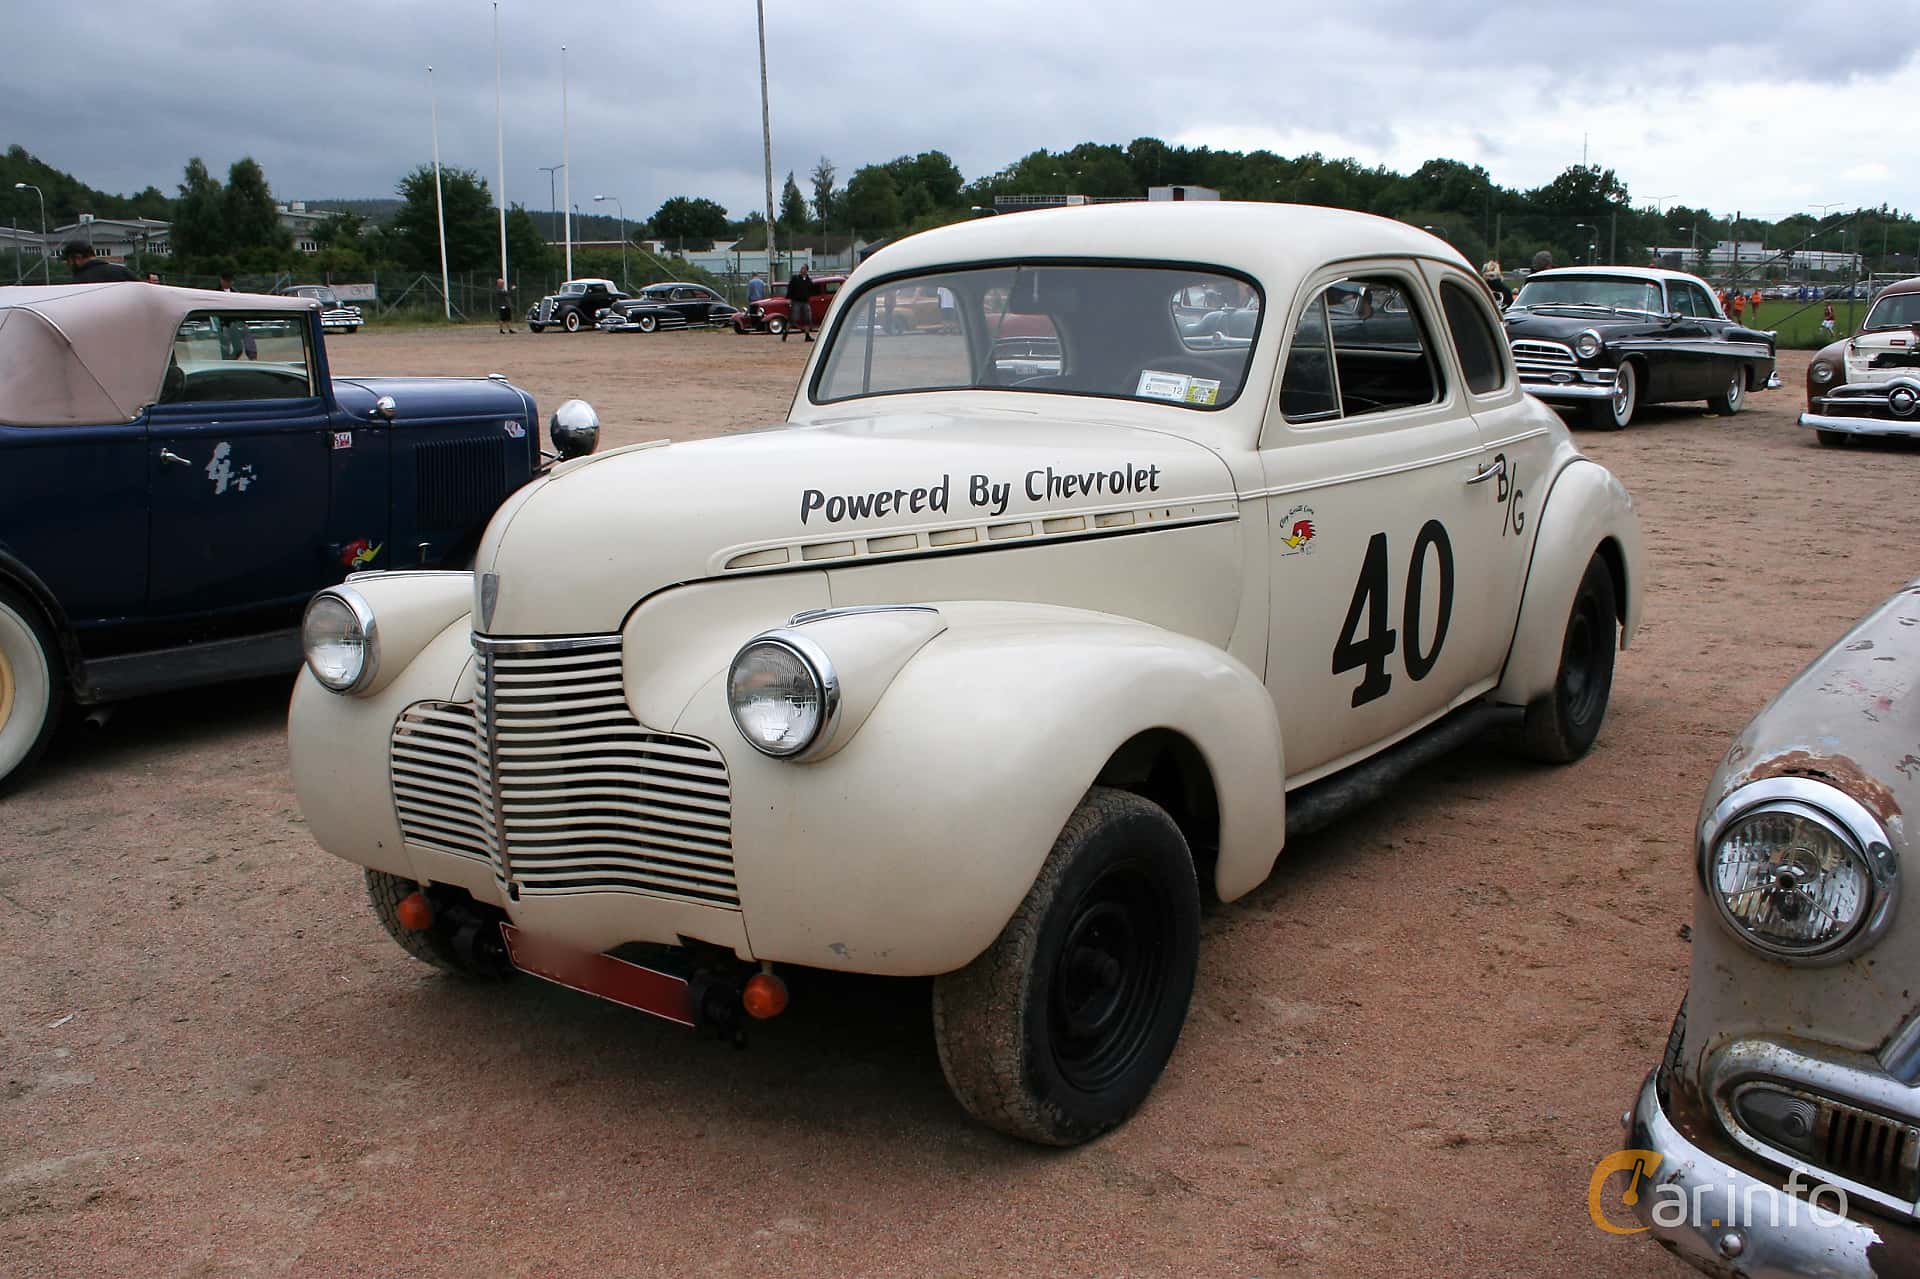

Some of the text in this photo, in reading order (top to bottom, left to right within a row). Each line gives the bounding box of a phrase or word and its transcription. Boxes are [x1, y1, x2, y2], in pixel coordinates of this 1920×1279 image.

[800, 463, 1161, 525] Powered By Chevrolet
[1332, 519, 1455, 708] 40
